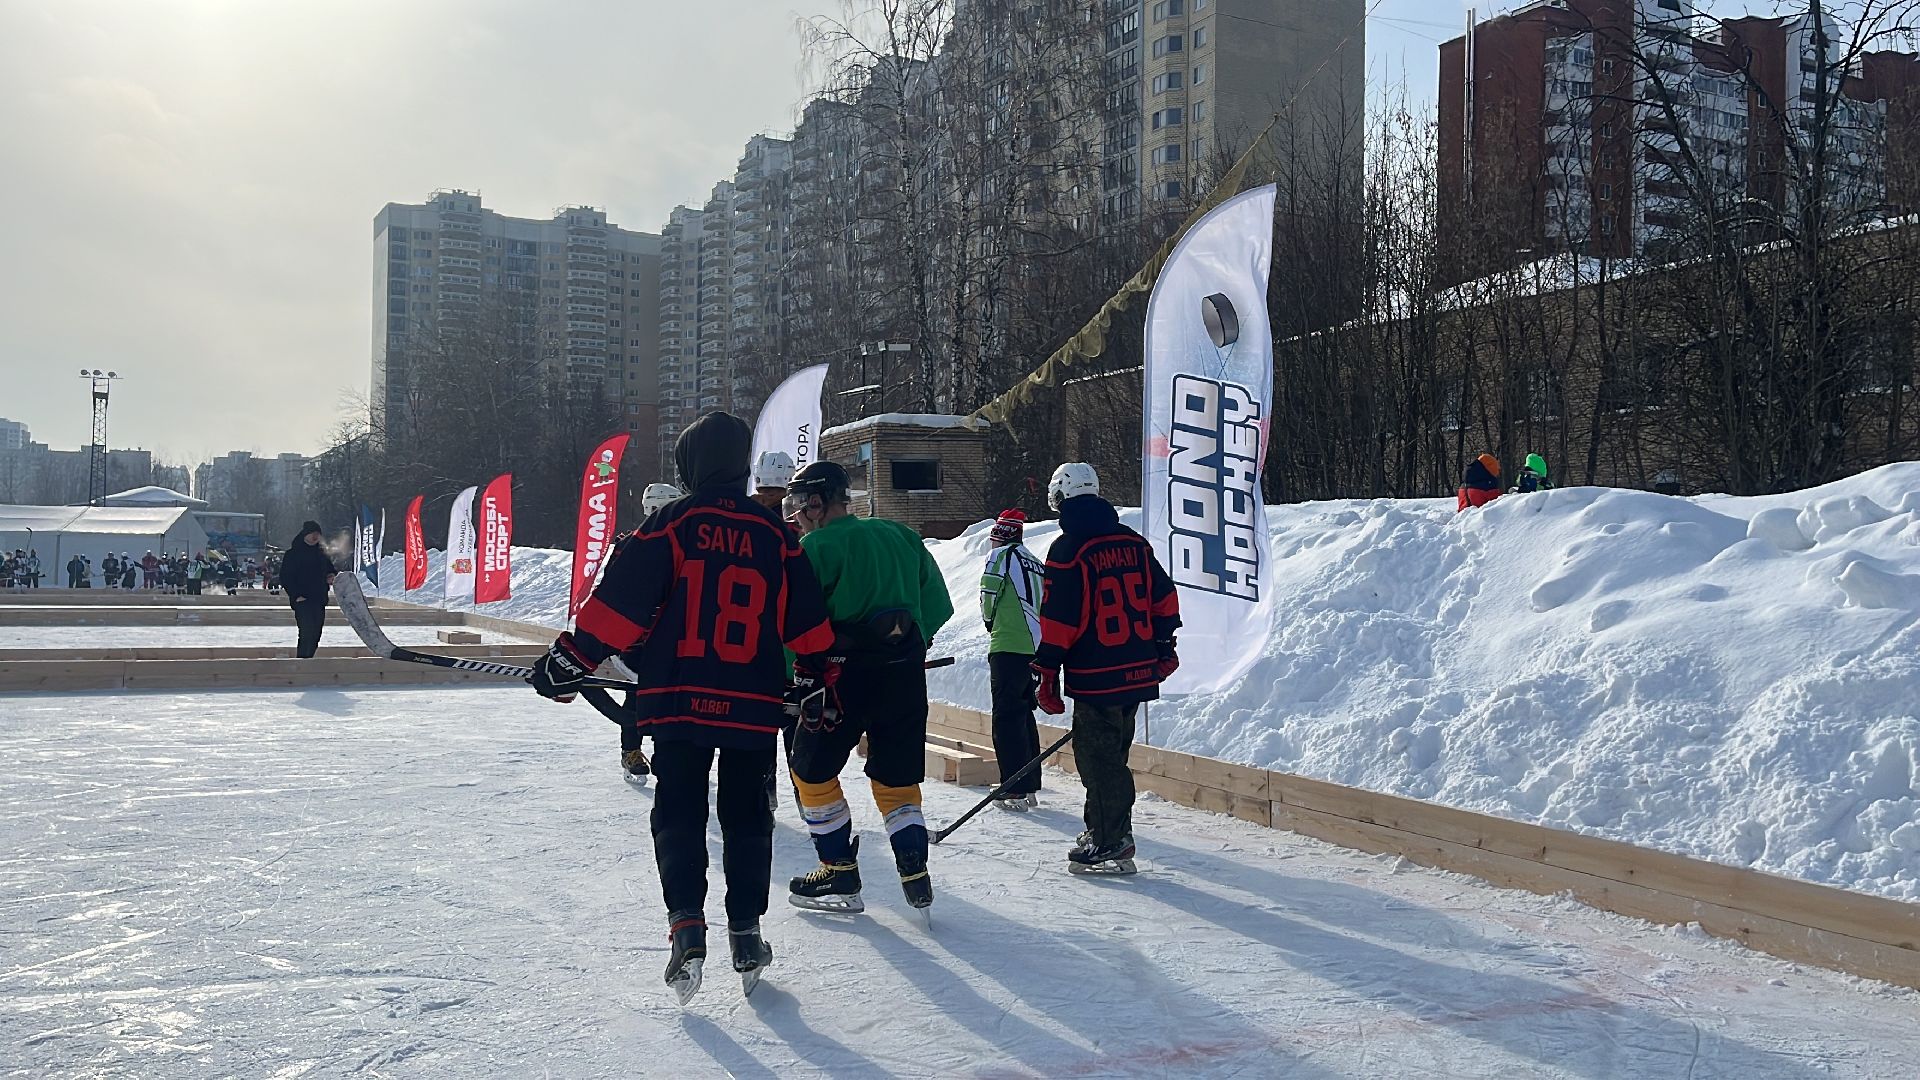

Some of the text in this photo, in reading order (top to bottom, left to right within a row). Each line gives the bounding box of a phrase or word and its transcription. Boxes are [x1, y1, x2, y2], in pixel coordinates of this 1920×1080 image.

[1170, 374, 1221, 592] POND
[1223, 381, 1261, 602] HOCKEY
[458, 519, 467, 554] КОМАНДА
[484, 497, 497, 572] МОСОБЛ
[495, 512, 509, 571] СПОРТ
[584, 492, 607, 577] ЗИМА
[1020, 558, 1045, 574] СУДЬ
[677, 560, 767, 664] 18
[1094, 572, 1153, 647] 85
[452, 660, 536, 679] WARR
[550, 646, 583, 676] UER
